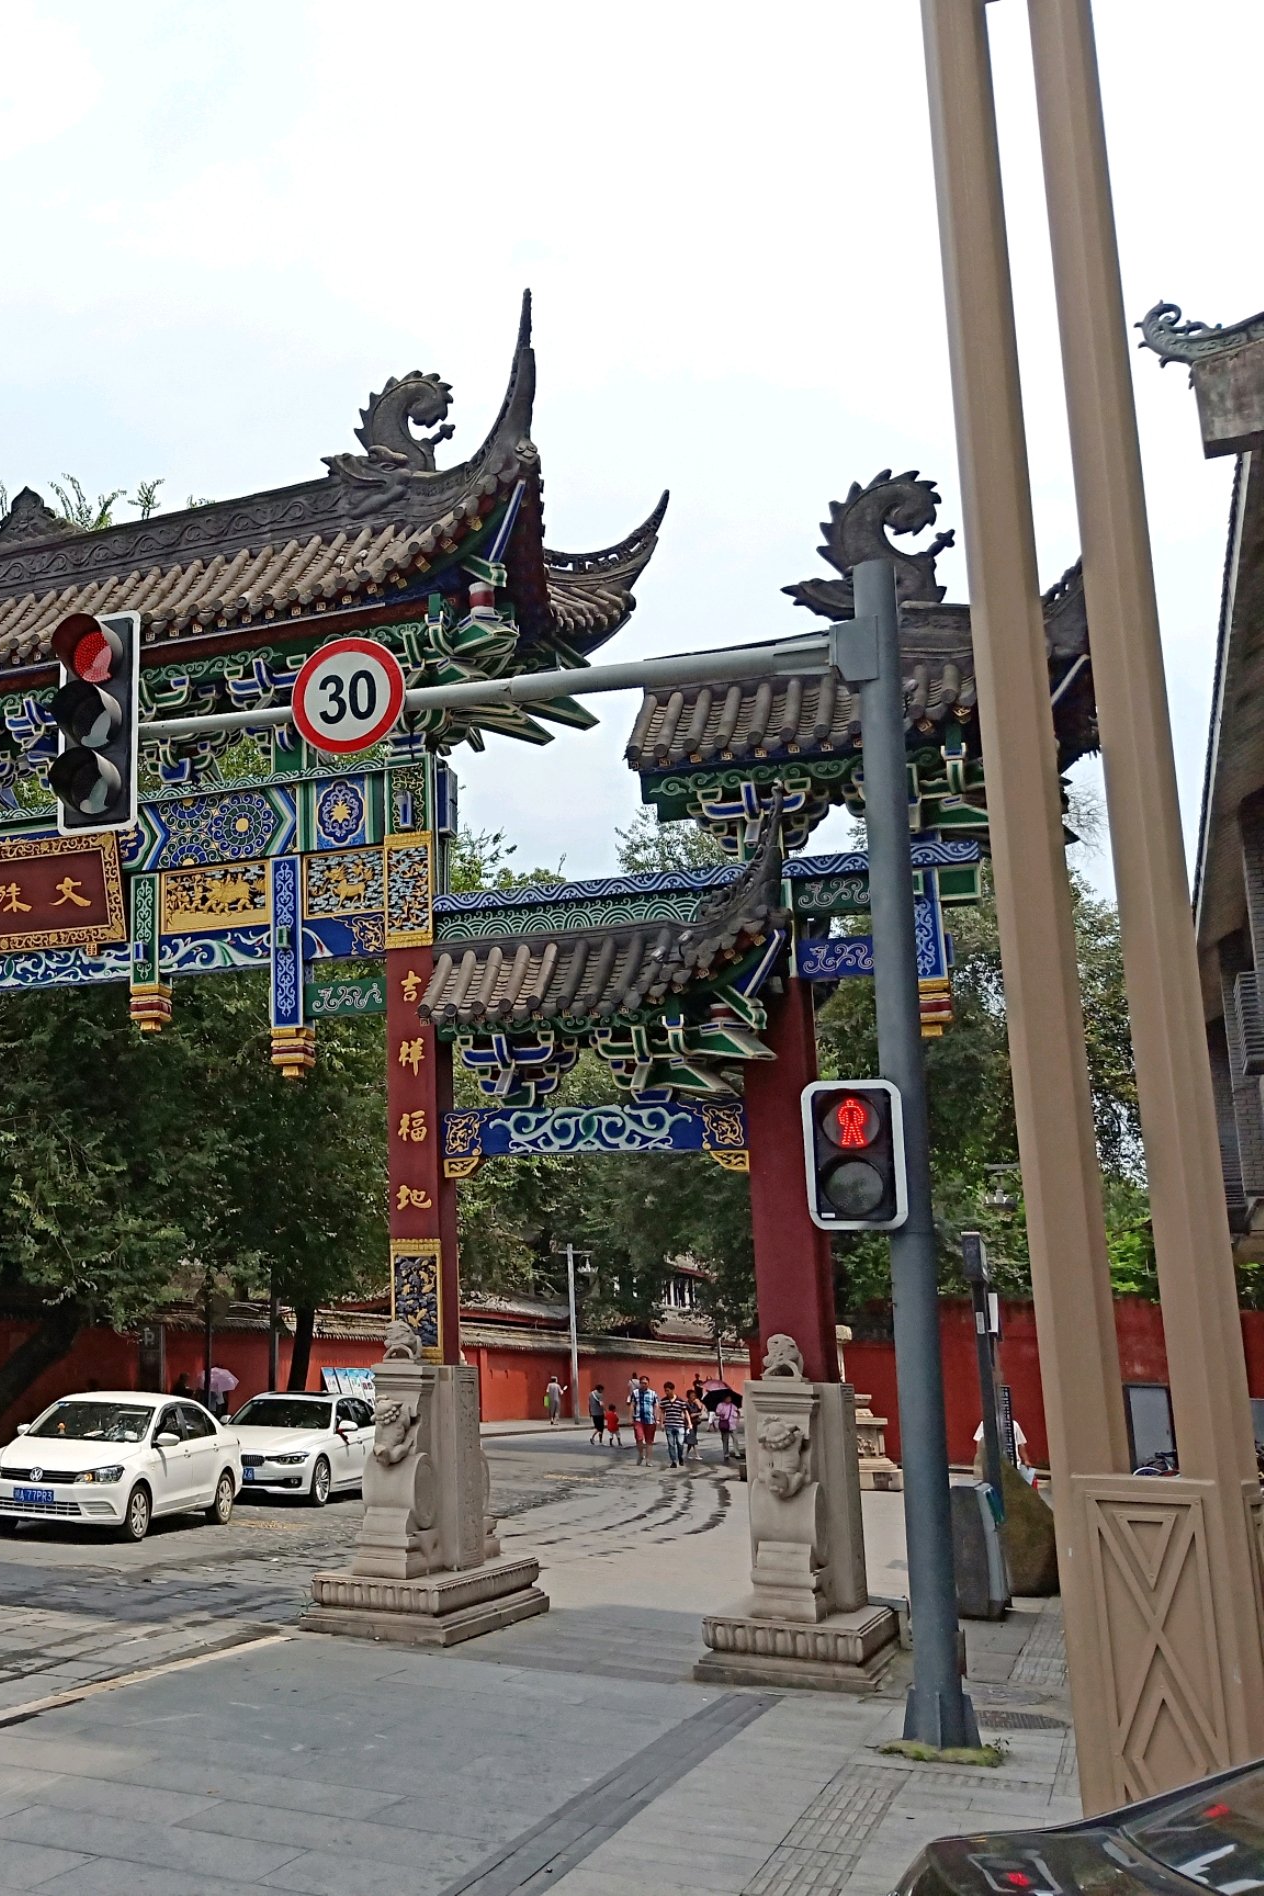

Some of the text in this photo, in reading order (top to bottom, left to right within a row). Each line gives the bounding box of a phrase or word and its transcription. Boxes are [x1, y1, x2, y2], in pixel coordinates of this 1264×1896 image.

[319, 670, 376, 725] 30
[396, 970, 432, 1210] 吉祥福地
